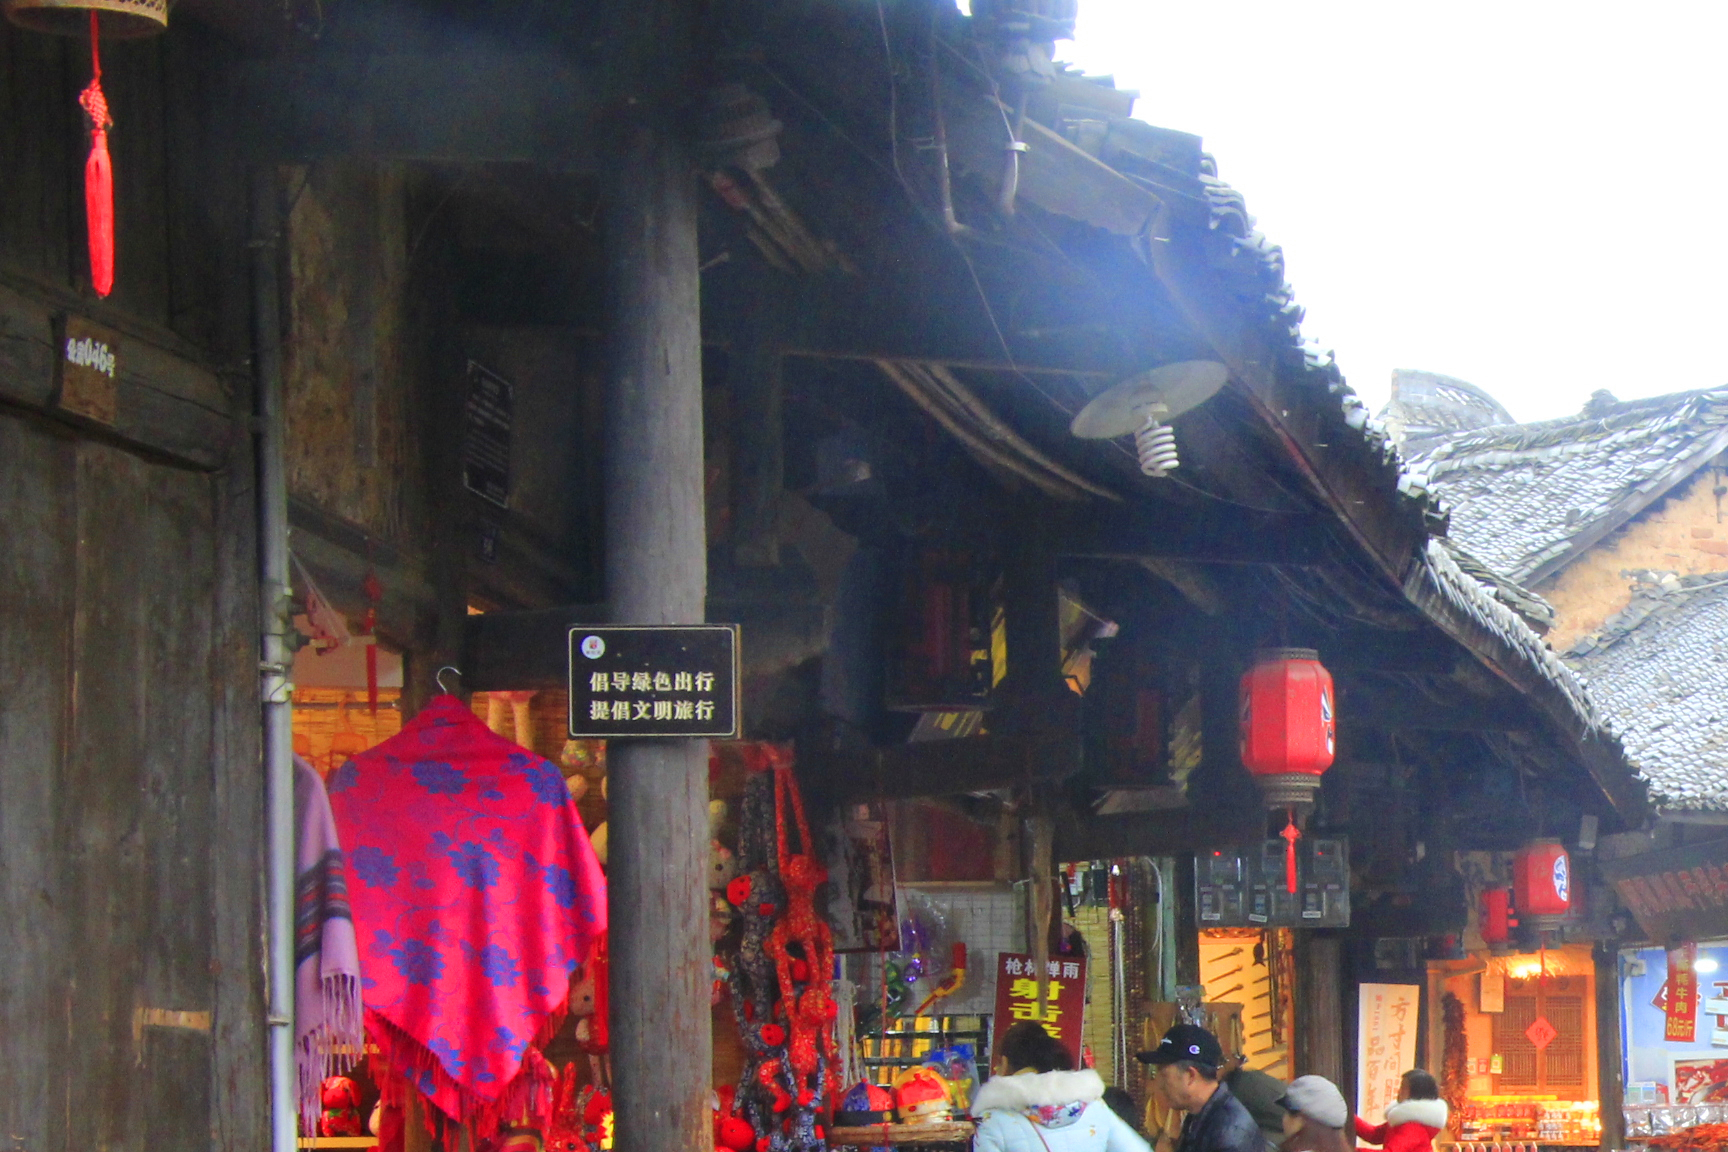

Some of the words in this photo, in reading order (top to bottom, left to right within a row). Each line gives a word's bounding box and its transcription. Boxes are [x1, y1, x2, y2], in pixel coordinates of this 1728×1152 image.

[590, 671, 715, 692] 倡导绿色出行
[590, 700, 715, 720] 提倡文明旅行
